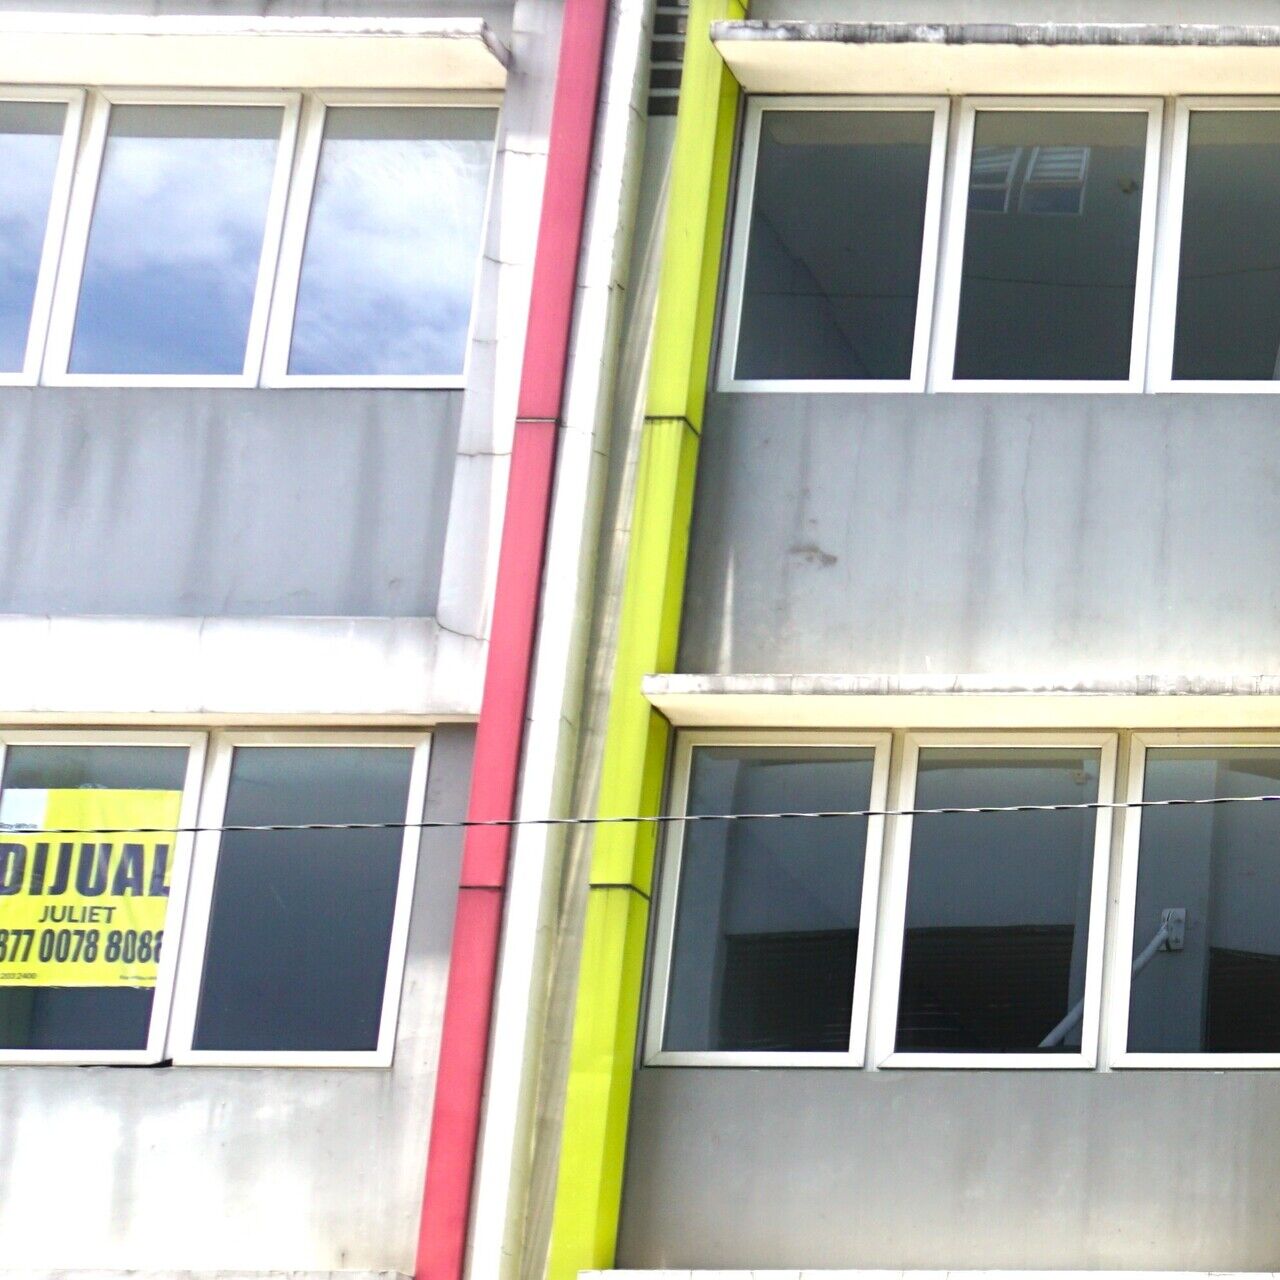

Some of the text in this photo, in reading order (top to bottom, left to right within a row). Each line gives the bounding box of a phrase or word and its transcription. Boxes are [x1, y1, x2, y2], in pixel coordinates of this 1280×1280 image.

[0, 842, 170, 897] DIJUAL
[38, 905, 117, 924] JULIET
[38, 928, 100, 963] 0078
